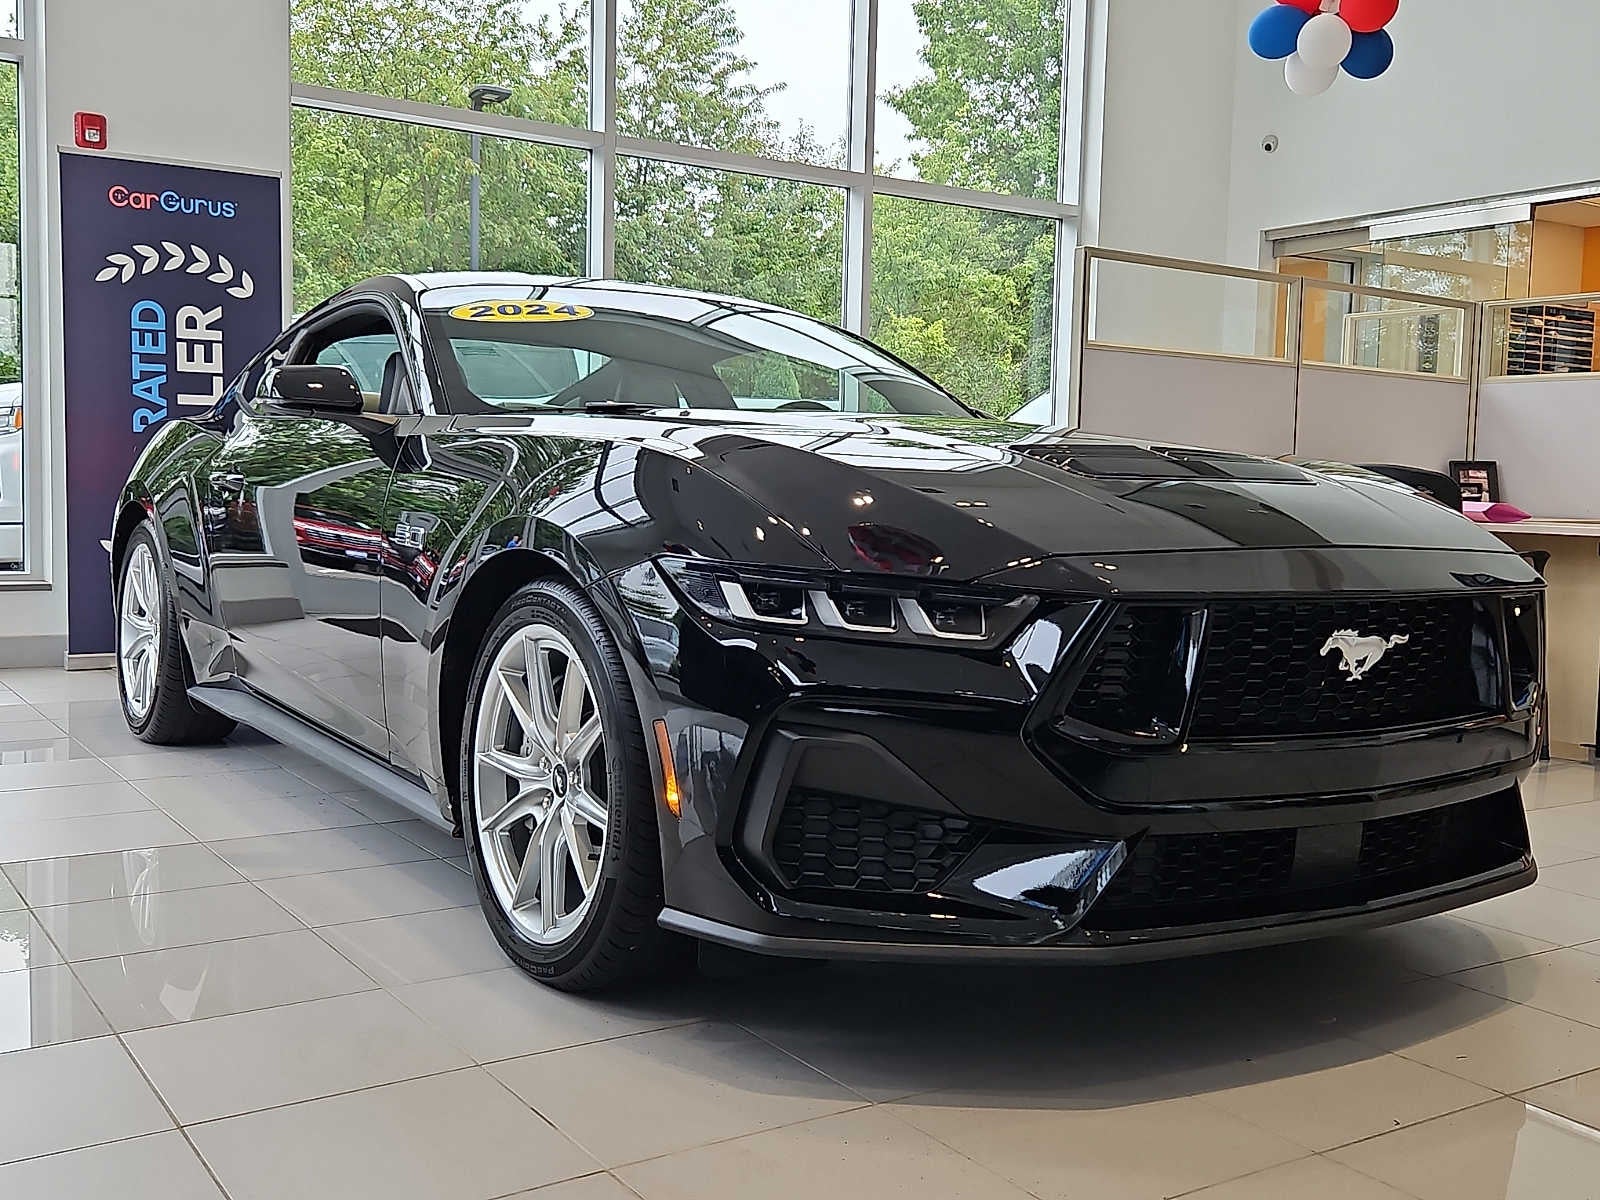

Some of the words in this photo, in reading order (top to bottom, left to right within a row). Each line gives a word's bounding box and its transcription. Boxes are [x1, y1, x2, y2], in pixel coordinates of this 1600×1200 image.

[107, 185, 236, 218] CarGurus
[469, 304, 579, 318] 2024
[131, 300, 167, 433] RATED
